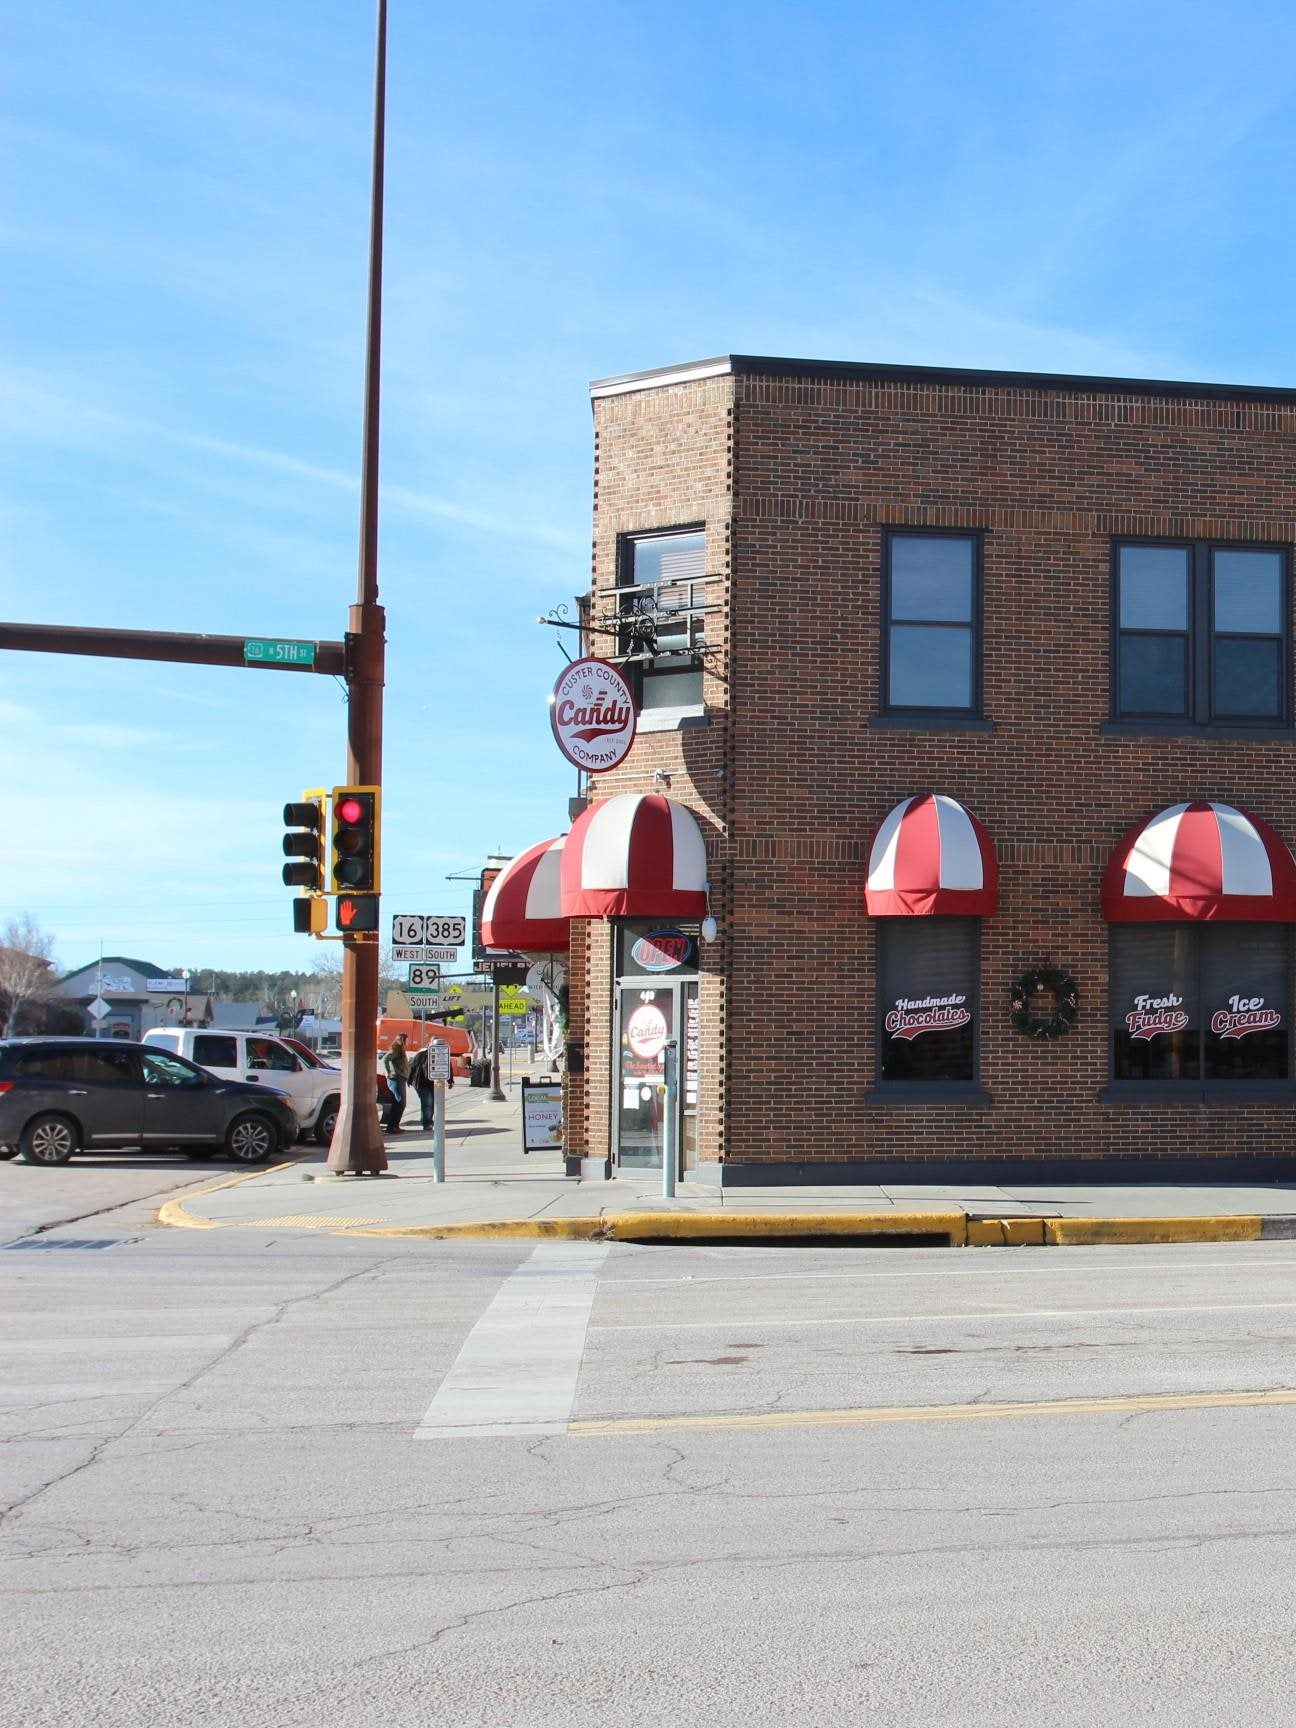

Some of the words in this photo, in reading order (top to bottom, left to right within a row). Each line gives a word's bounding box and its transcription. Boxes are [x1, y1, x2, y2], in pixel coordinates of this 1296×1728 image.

[276, 644, 298, 660] 5TH
[562, 667, 593, 696] CUSTER
[595, 668, 630, 704] COUNTY
[557, 699, 631, 731] Candy
[572, 745, 617, 765] COMPANY
[398, 922, 418, 939] 16
[430, 922, 462, 939] 385
[395, 948, 420, 959] WEST
[428, 949, 456, 960] SOUTH
[638, 937, 688, 964] OPEN
[411, 968, 437, 985] 89
[410, 996, 438, 1007] SOUTH
[499, 1002, 525, 1010] AHEAD
[895, 993, 966, 1011] Handmade
[1134, 993, 1183, 1011] Fresh
[1228, 995, 1265, 1012] Ice
[885, 1006, 971, 1033] Chocolates
[1125, 1009, 1189, 1034] Fudge
[1211, 1009, 1281, 1034] Cream
[630, 1023, 665, 1040] Candy
[528, 1112, 559, 1121] HONEY
